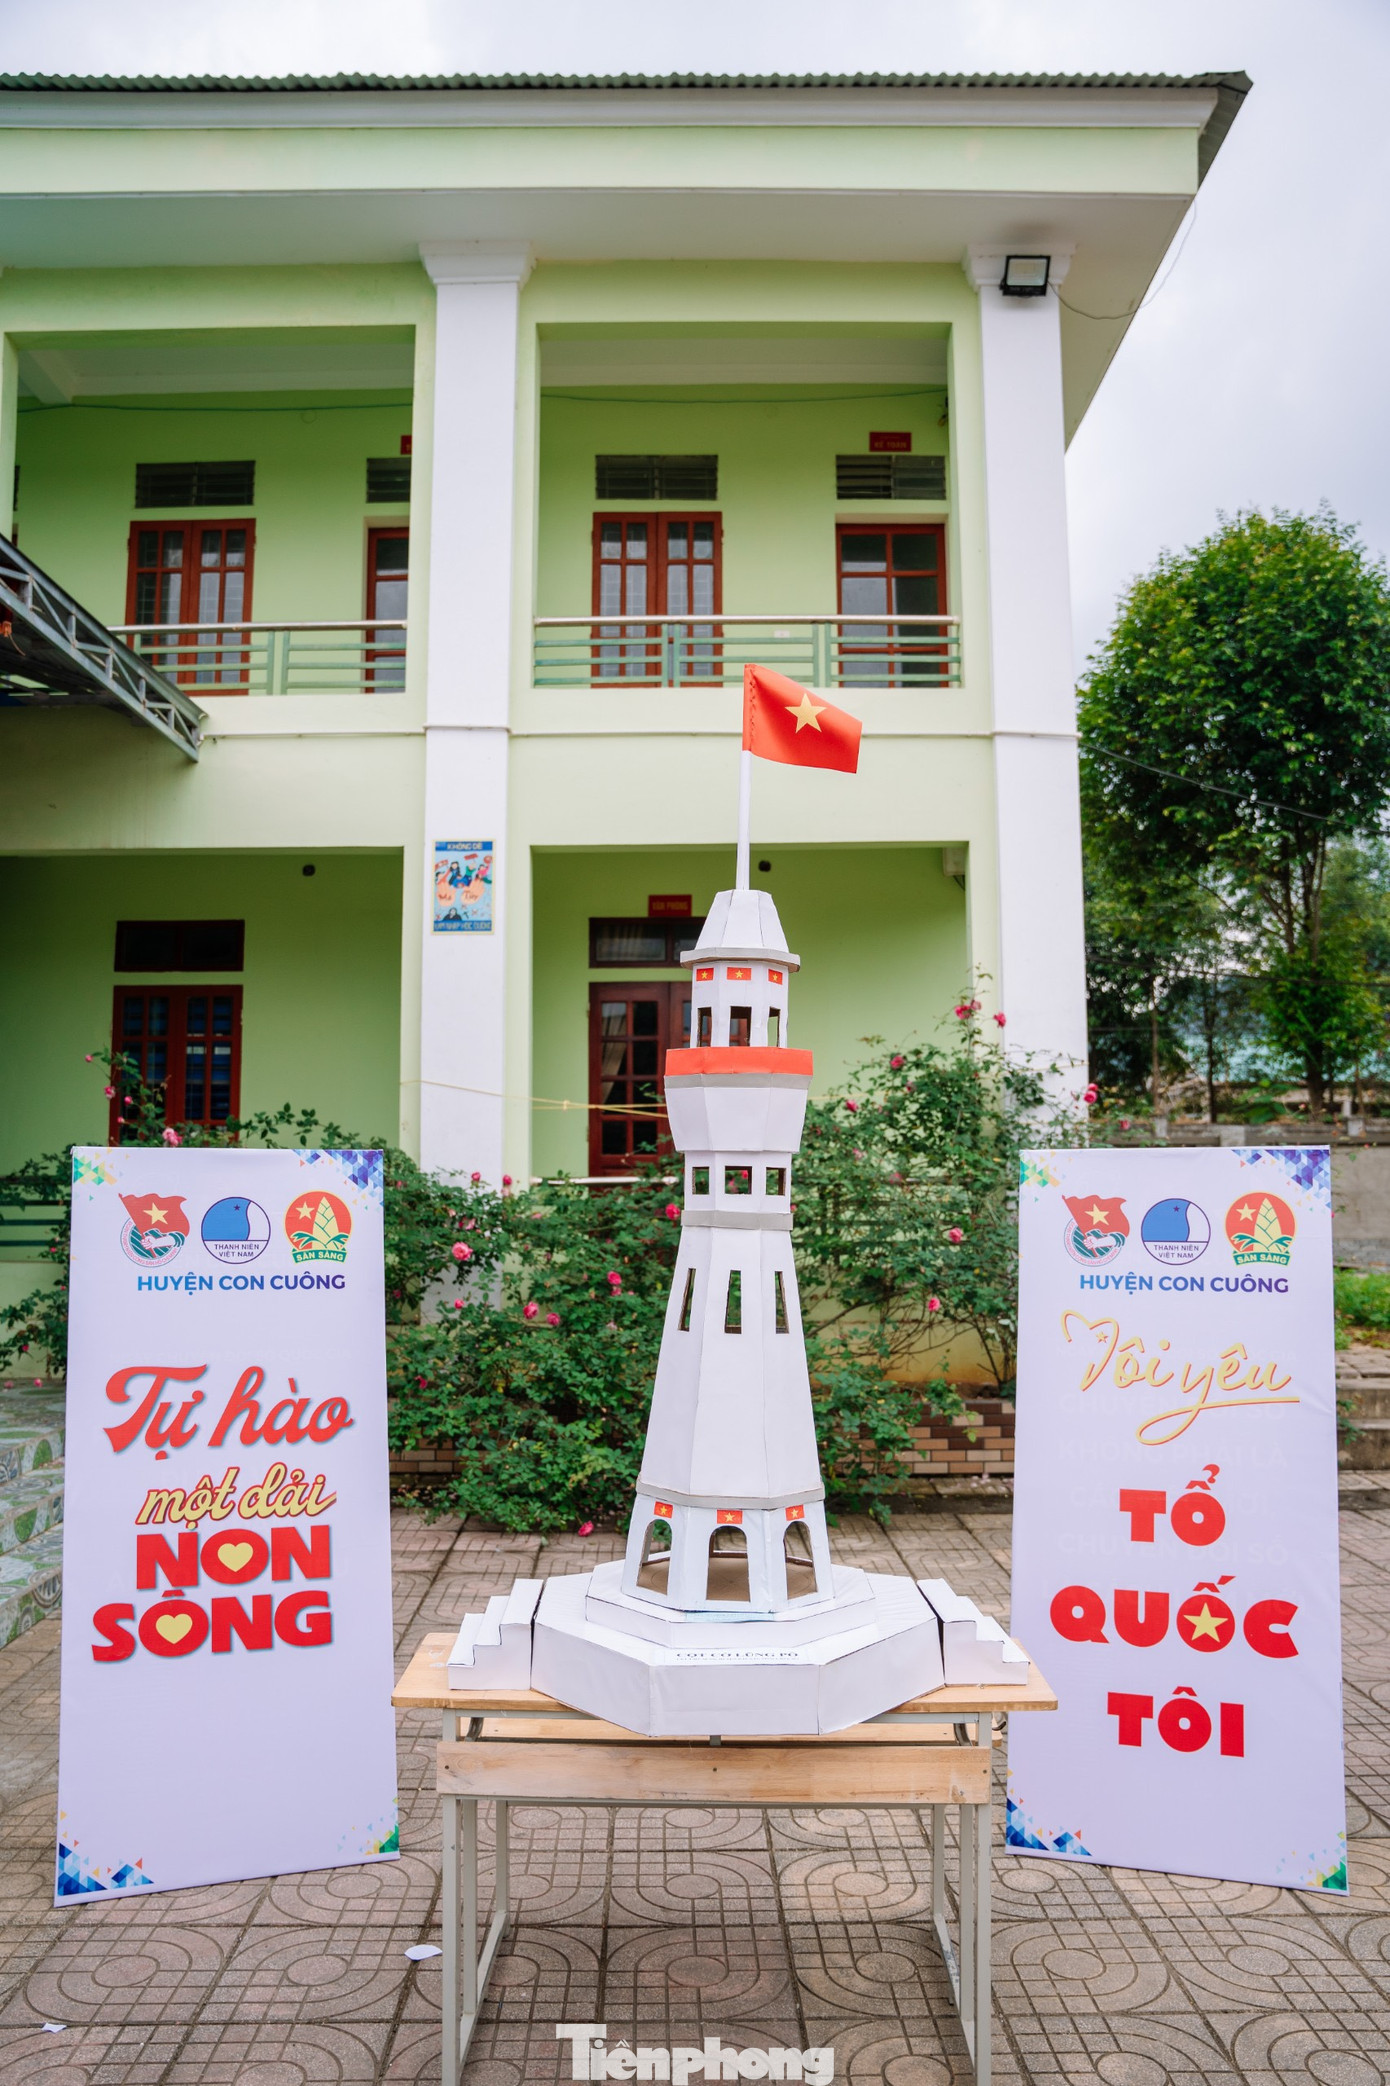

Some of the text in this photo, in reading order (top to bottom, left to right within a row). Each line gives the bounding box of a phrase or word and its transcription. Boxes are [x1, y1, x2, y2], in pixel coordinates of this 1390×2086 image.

[241, 1241, 260, 1250] NIÊN
[1181, 1243, 1199, 1251] NIÊN
[137, 1271, 346, 1296] HUYỆN CON CUÔNG
[1080, 1272, 1289, 1295] HUYỆN CON CUÔNG
[103, 1363, 354, 1461] Tự hào
[1061, 1309, 1300, 1446] Tôi yêu
[135, 1461, 337, 1530] một dải
[1119, 1463, 1226, 1547] TỔ
[136, 1524, 331, 1590] NON
[91, 1588, 332, 1663] SÔNG
[1050, 1575, 1299, 1659] QUỐC
[1107, 1685, 1245, 1758] TÔI
